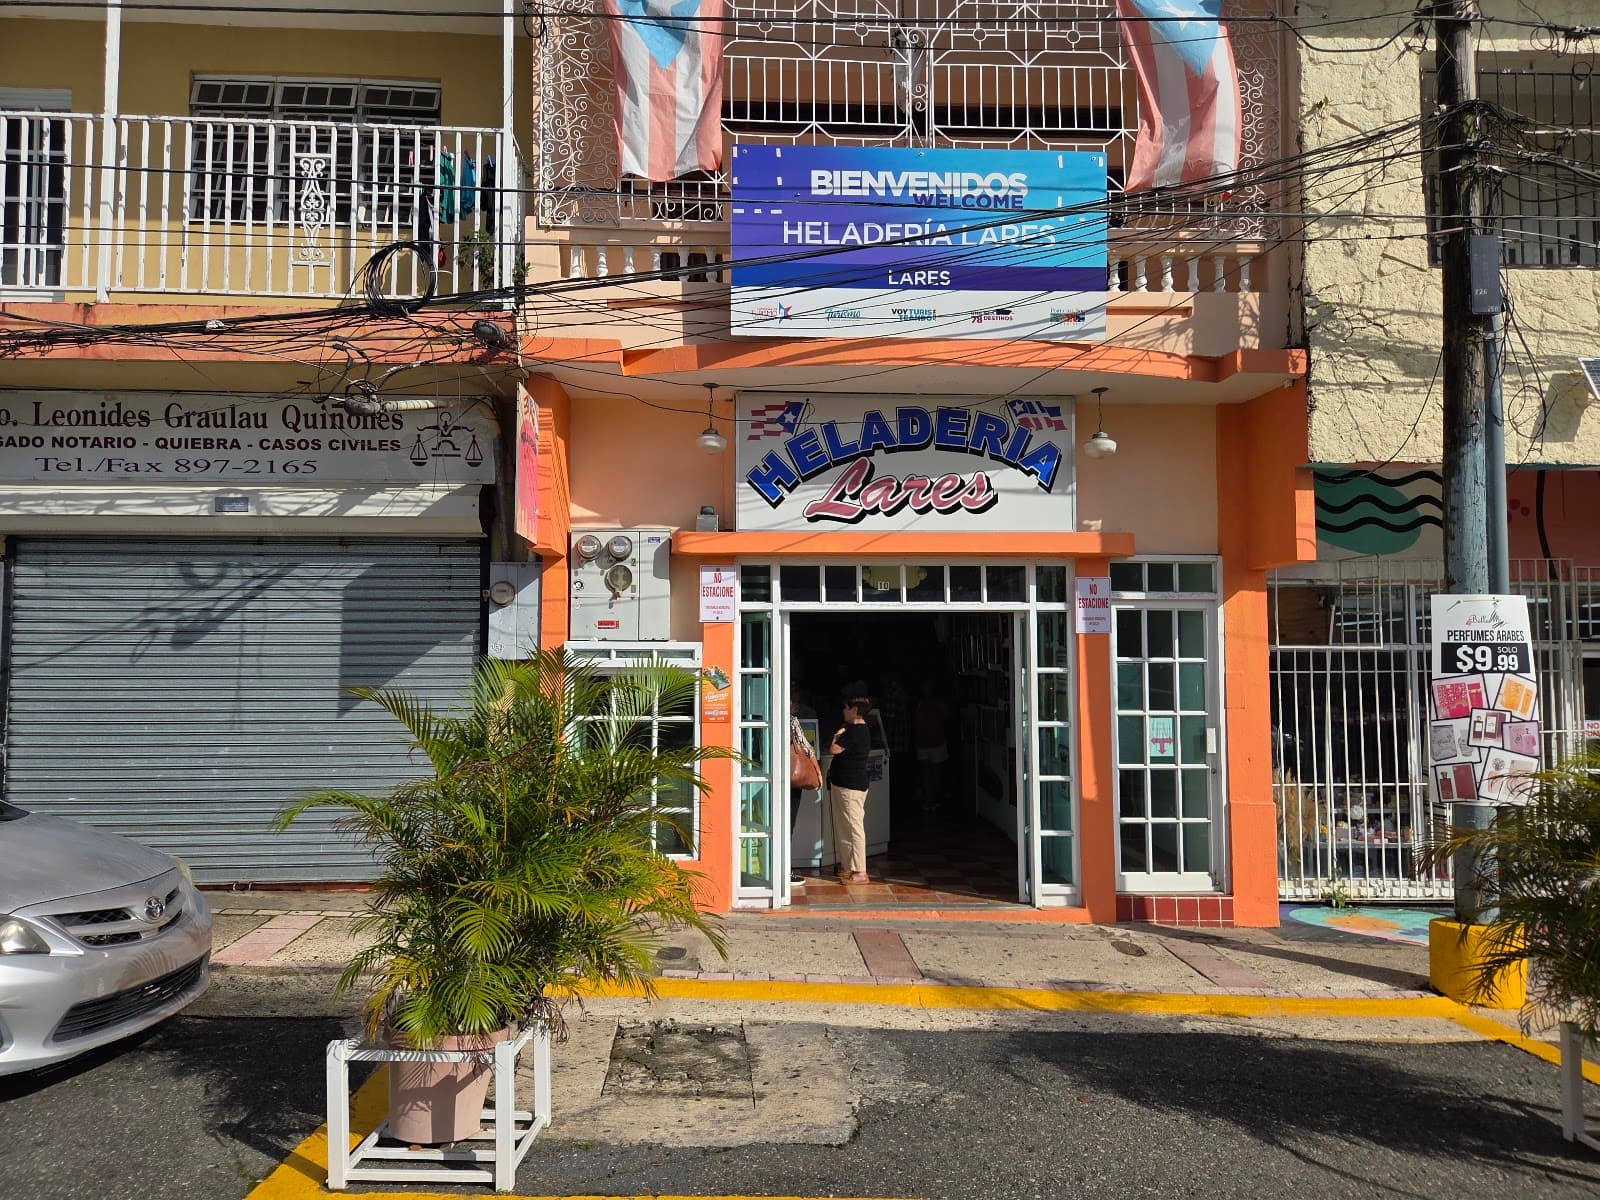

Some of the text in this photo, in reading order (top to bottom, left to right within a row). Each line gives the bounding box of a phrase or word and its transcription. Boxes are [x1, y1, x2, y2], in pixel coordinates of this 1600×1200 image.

[810, 169, 1028, 197] BIENVENIDOS
[912, 194, 1024, 209] WELCOME
[783, 218, 1056, 247] HELADERÍA LARES
[888, 269, 951, 286] LARES
[32, 401, 151, 427] Leonides
[164, 403, 268, 430] Graulau
[51, 436, 137, 449] NOTARIO
[155, 437, 242, 450] QUIEBRA
[258, 438, 322, 451] CASOS
[328, 439, 401, 452] CIVILES
[746, 405, 1062, 509] HELADERIA
[35, 457, 318, 474] Tel./Fax 897-2165
[802, 456, 999, 524] Lares
[713, 572, 722, 583] NO
[703, 586, 734, 598] ESTACIONE
[1089, 584, 1098, 595] NO
[1079, 598, 1109, 609] ESTACIONE
[1447, 630, 1525, 641] PERFUMES ARABES
[1497, 646, 1518, 654] SOLO
[1456, 645, 1519, 672] $9.99
